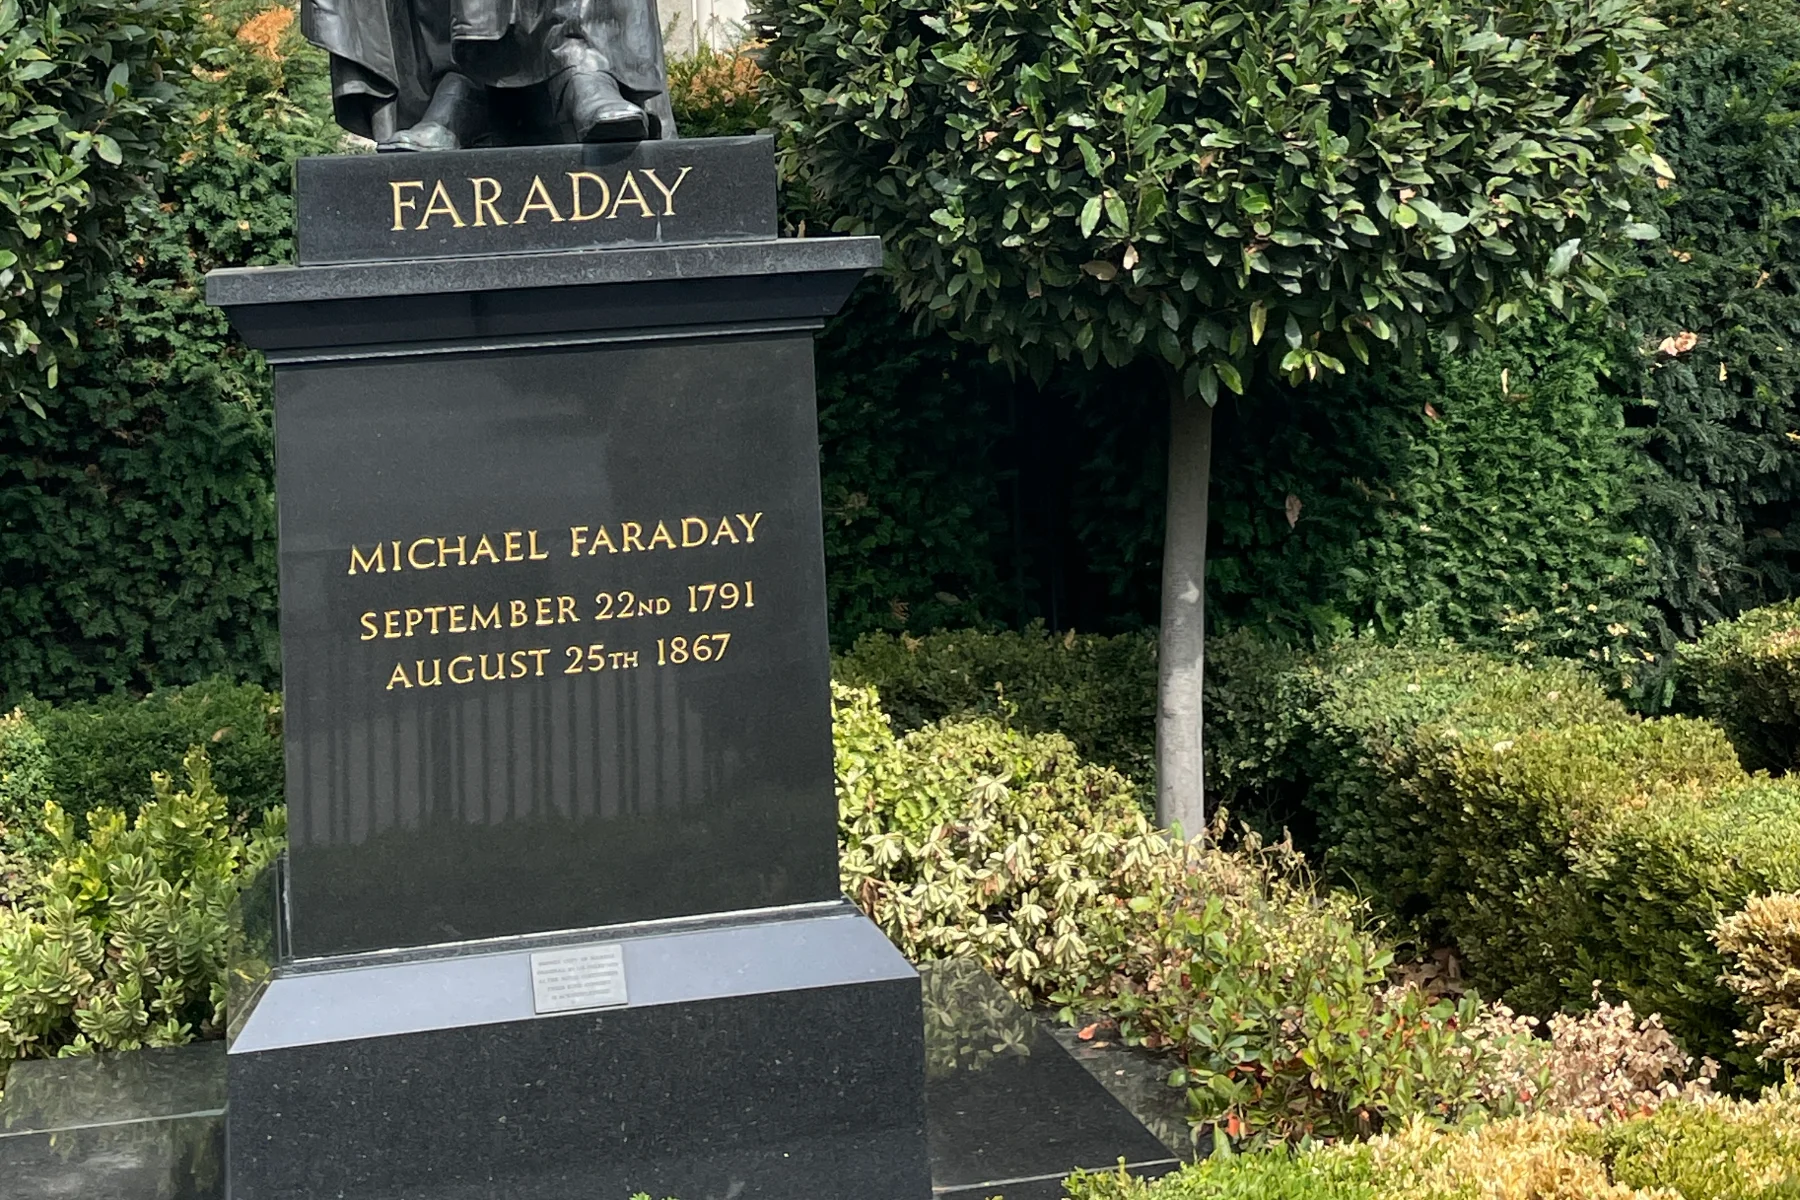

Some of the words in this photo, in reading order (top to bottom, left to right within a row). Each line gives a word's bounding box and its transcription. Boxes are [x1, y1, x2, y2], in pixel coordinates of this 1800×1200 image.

[388, 166, 693, 232] FARADAY
[347, 529, 550, 576] MICHAEL
[569, 511, 764, 558] FARADAY
[359, 595, 581, 641] SEPTEMBER
[594, 590, 672, 621] 22ND
[688, 579, 756, 613] 1791
[385, 647, 552, 690] AUGUST
[563, 643, 639, 675] 25TH
[656, 632, 732, 667] 1867
